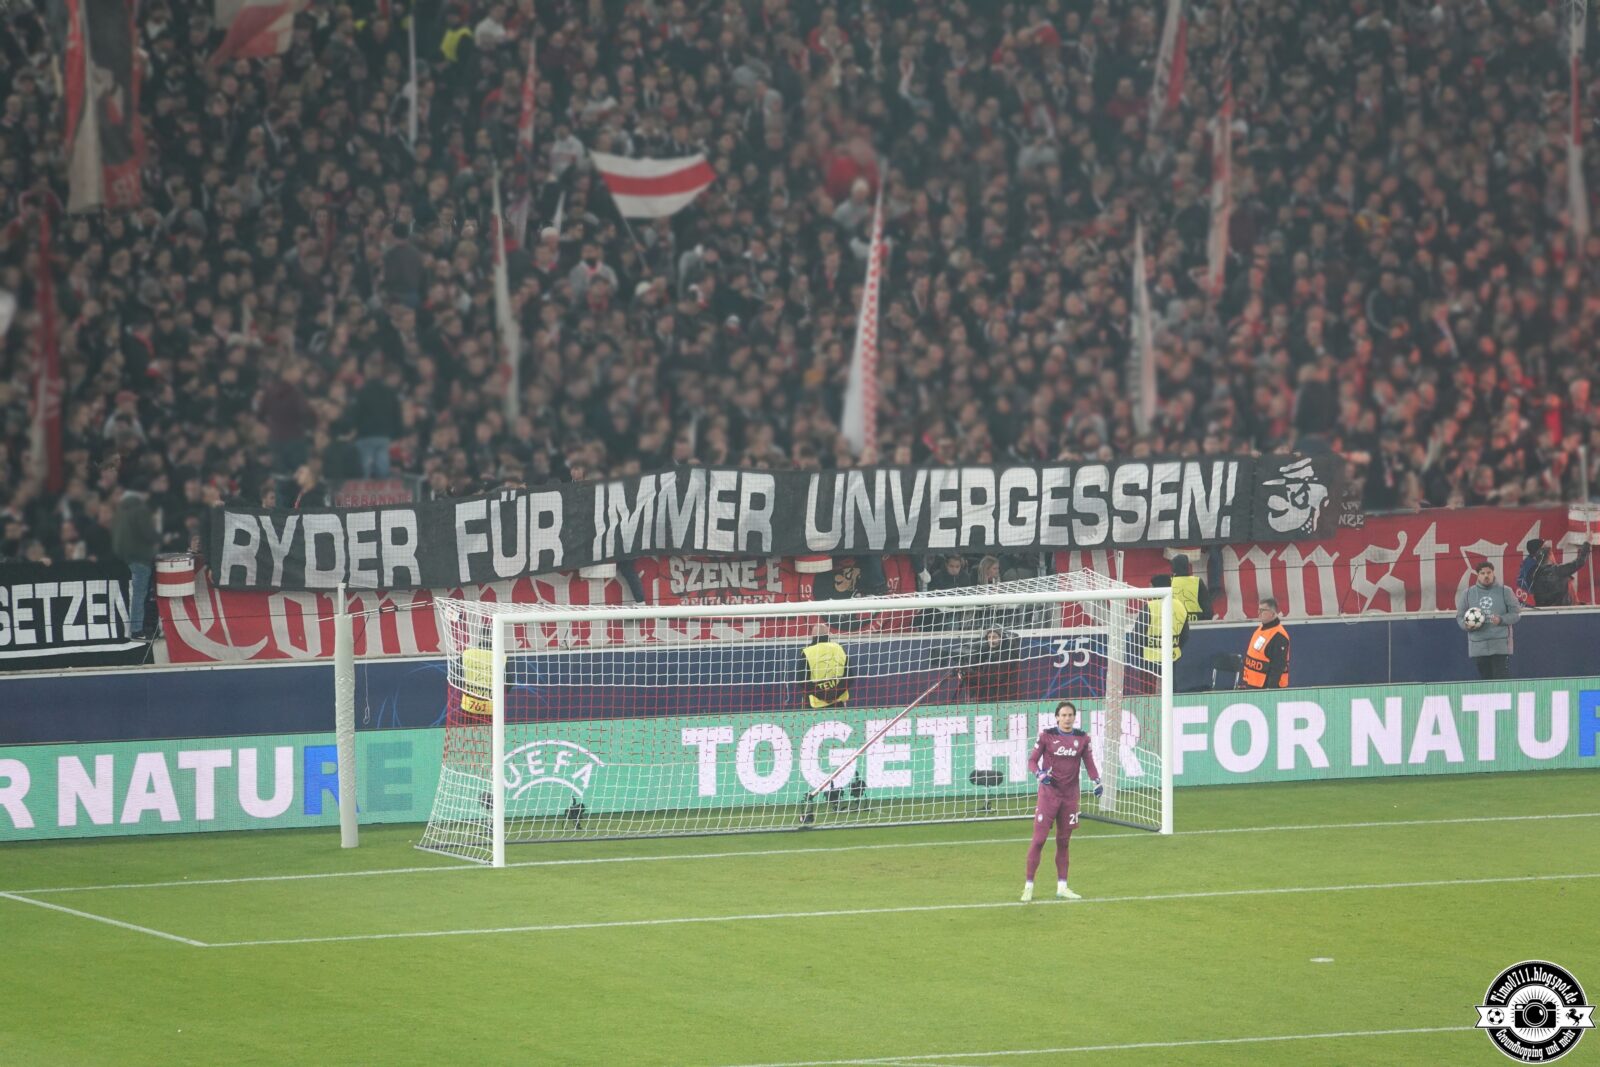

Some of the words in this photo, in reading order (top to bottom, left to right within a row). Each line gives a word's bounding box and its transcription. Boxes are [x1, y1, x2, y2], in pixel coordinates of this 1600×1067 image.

[219, 509, 422, 589] RYDER
[455, 490, 565, 583] FÜR
[593, 467, 776, 562] IMMER
[804, 461, 1239, 551] UNVERGESSEN!
[669, 556, 759, 593] SZENE
[766, 557, 783, 593] E
[1053, 637, 1090, 668] 35
[1172, 701, 1330, 776] FOR
[504, 749, 593, 789] UEFA
